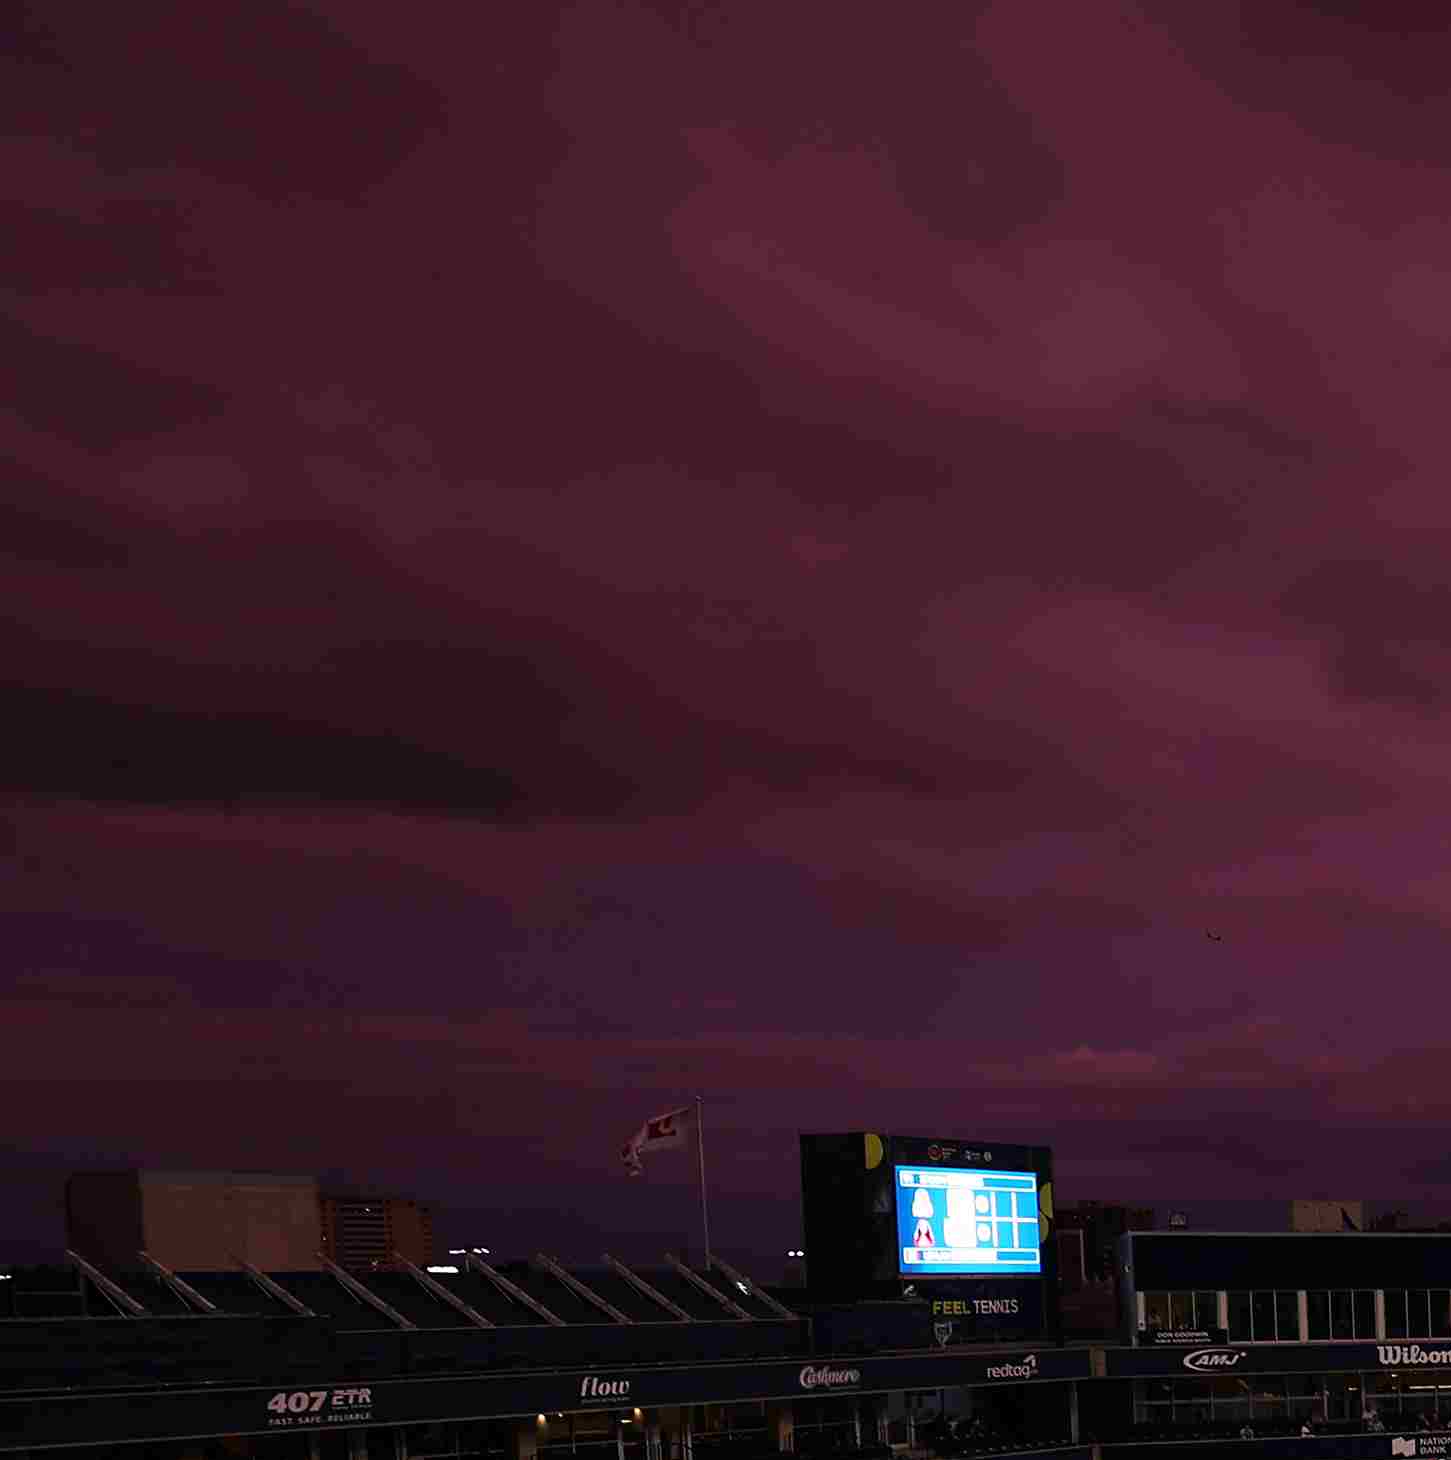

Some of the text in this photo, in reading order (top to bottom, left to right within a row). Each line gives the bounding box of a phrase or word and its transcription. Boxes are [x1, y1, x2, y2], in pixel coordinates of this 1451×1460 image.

[933, 1299, 1019, 1315] FEEL TENNIS
[581, 1376, 630, 1397] flow
[267, 1388, 372, 1413] 407 ETR
[1420, 1446, 1447, 1455] BANK
